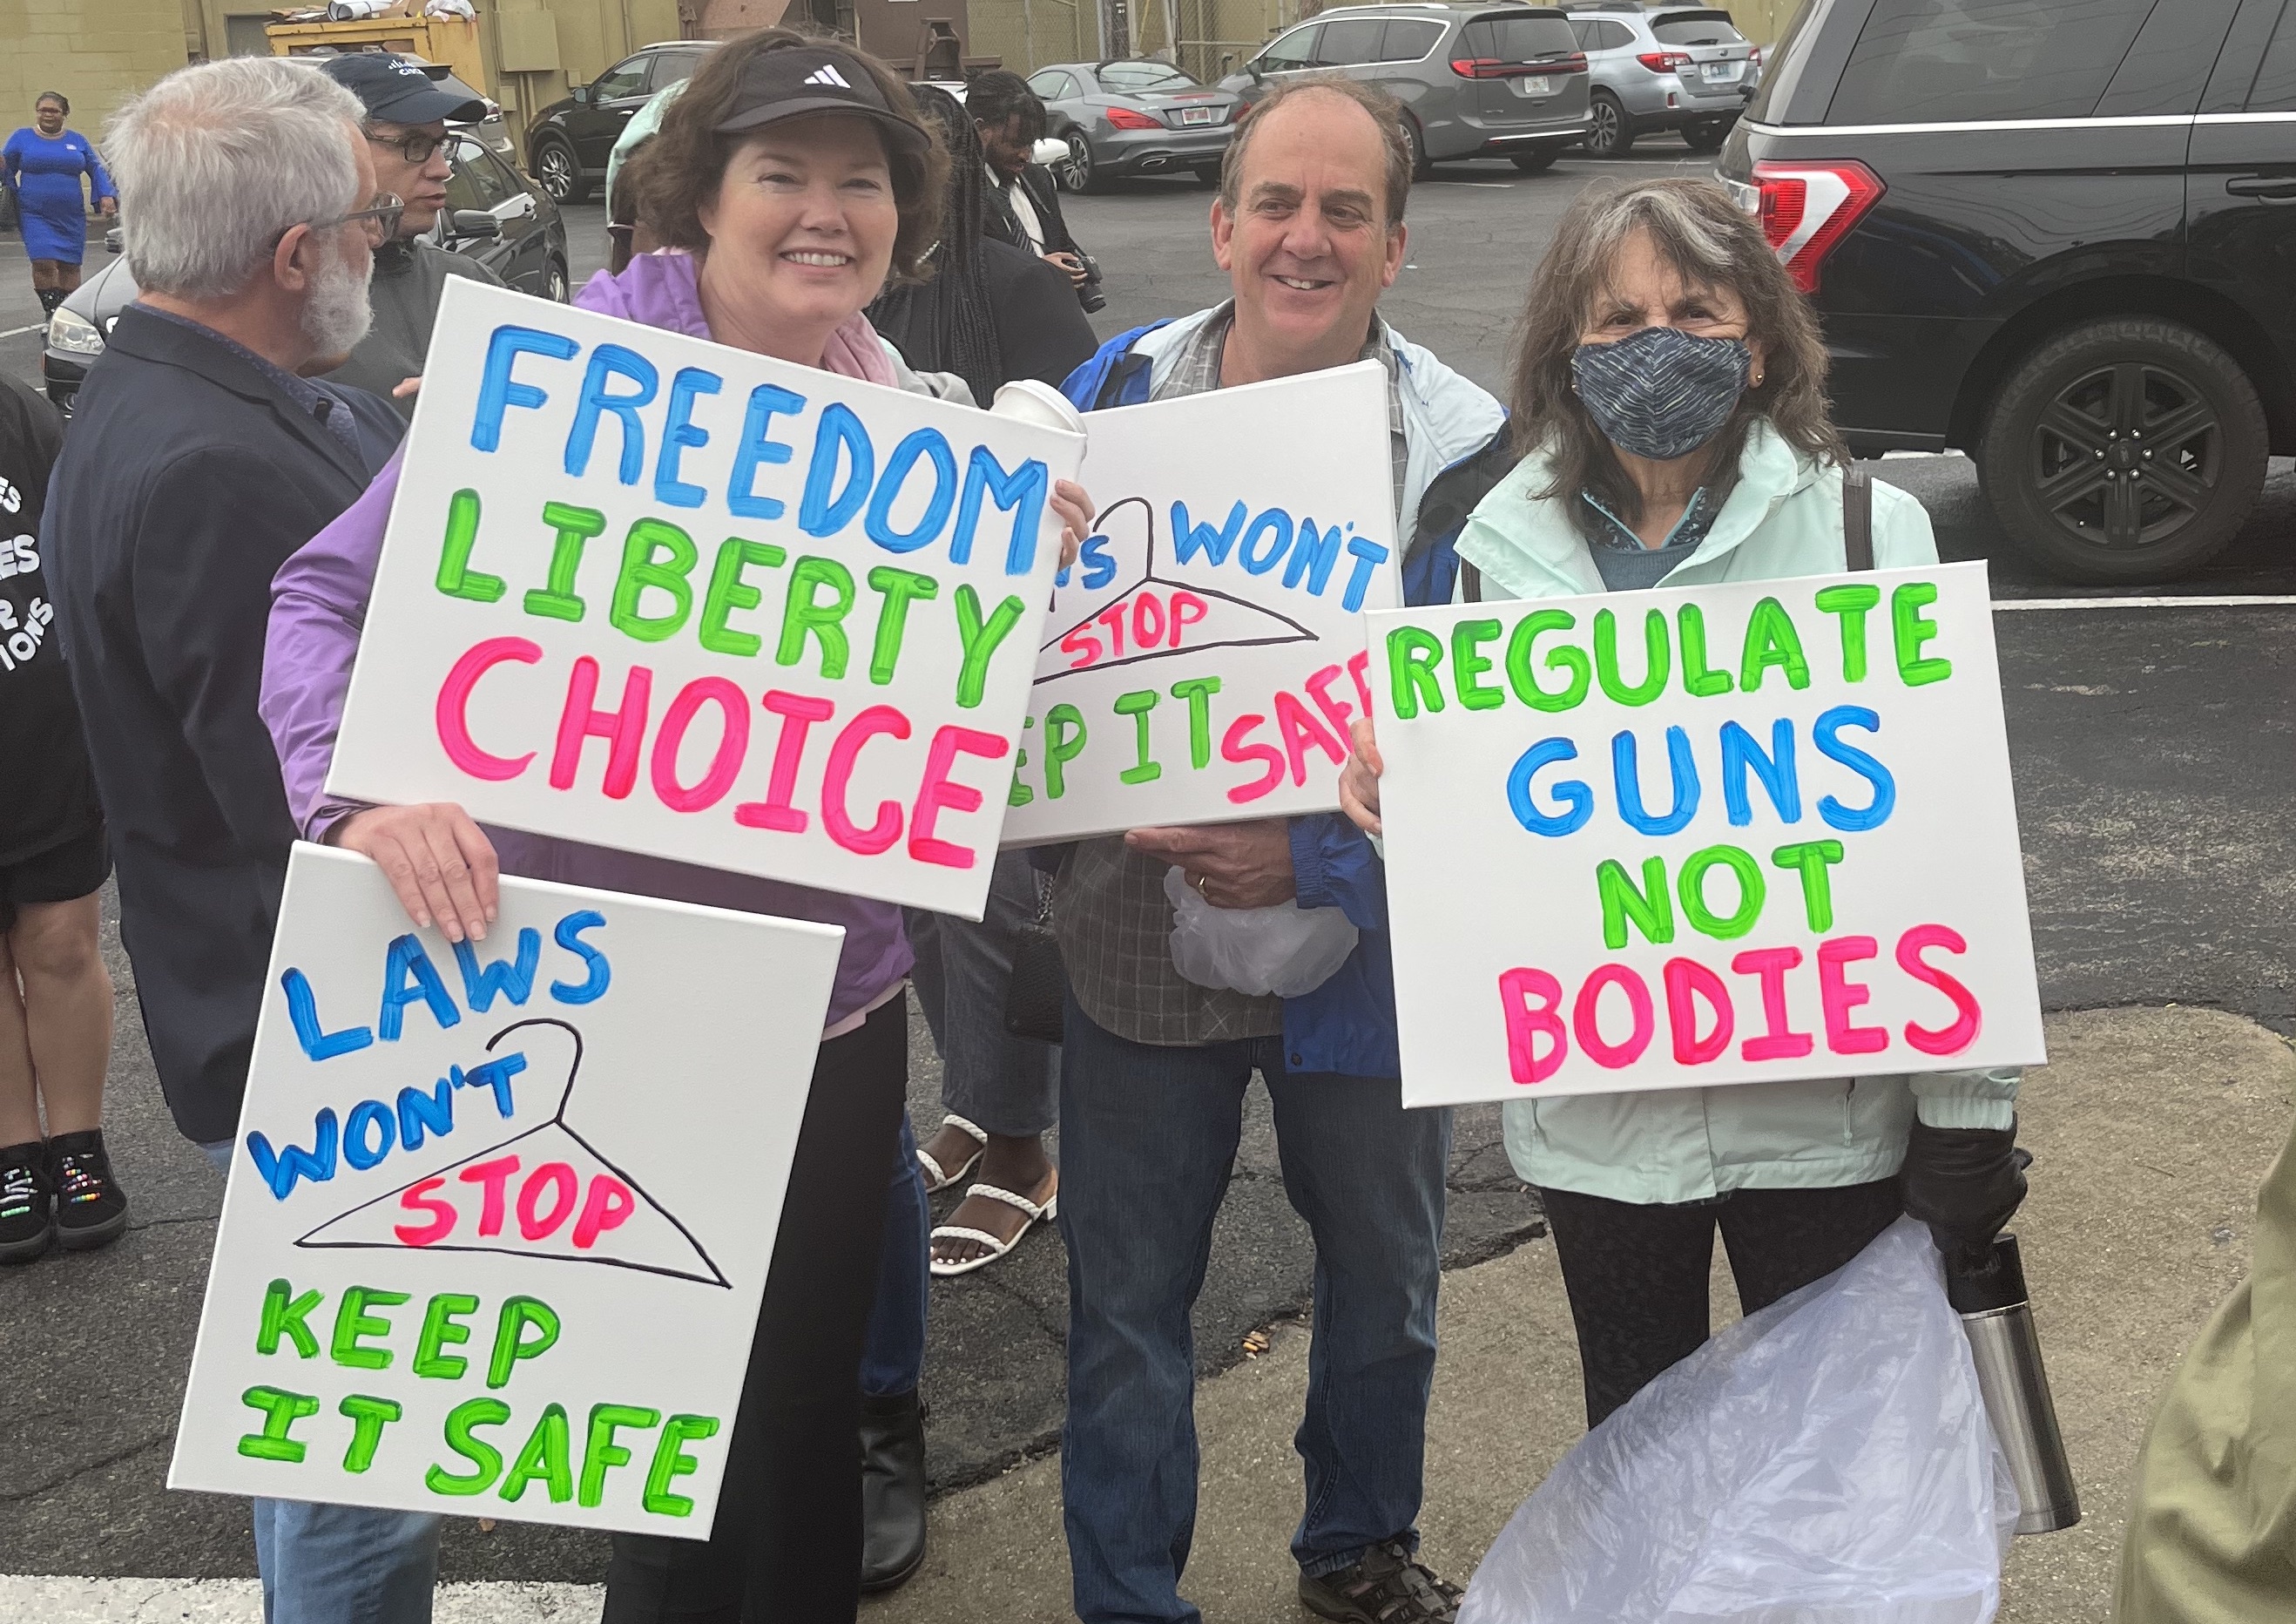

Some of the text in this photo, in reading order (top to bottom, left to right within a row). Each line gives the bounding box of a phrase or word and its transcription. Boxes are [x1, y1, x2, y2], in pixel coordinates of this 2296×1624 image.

[470, 325, 1049, 576] FREEDOM
[436, 488, 1024, 708] LIBERTY
[1170, 499, 1389, 613] WON'T
[1060, 591, 1208, 672] STOP
[1386, 582, 1953, 720] REGULATE
[436, 636, 1010, 870] CHOICE
[1114, 676, 1222, 785] IT
[1506, 704, 1896, 838] GUNS
[1597, 839, 1845, 950] NOT
[280, 909, 611, 1062] LAWS
[1498, 924, 1982, 1086] BODIES
[246, 1052, 527, 1201] WON'T
[394, 1154, 636, 1249] STOP
[255, 1278, 561, 1390] KEEP
[237, 1385, 721, 1518] IT SAFE
